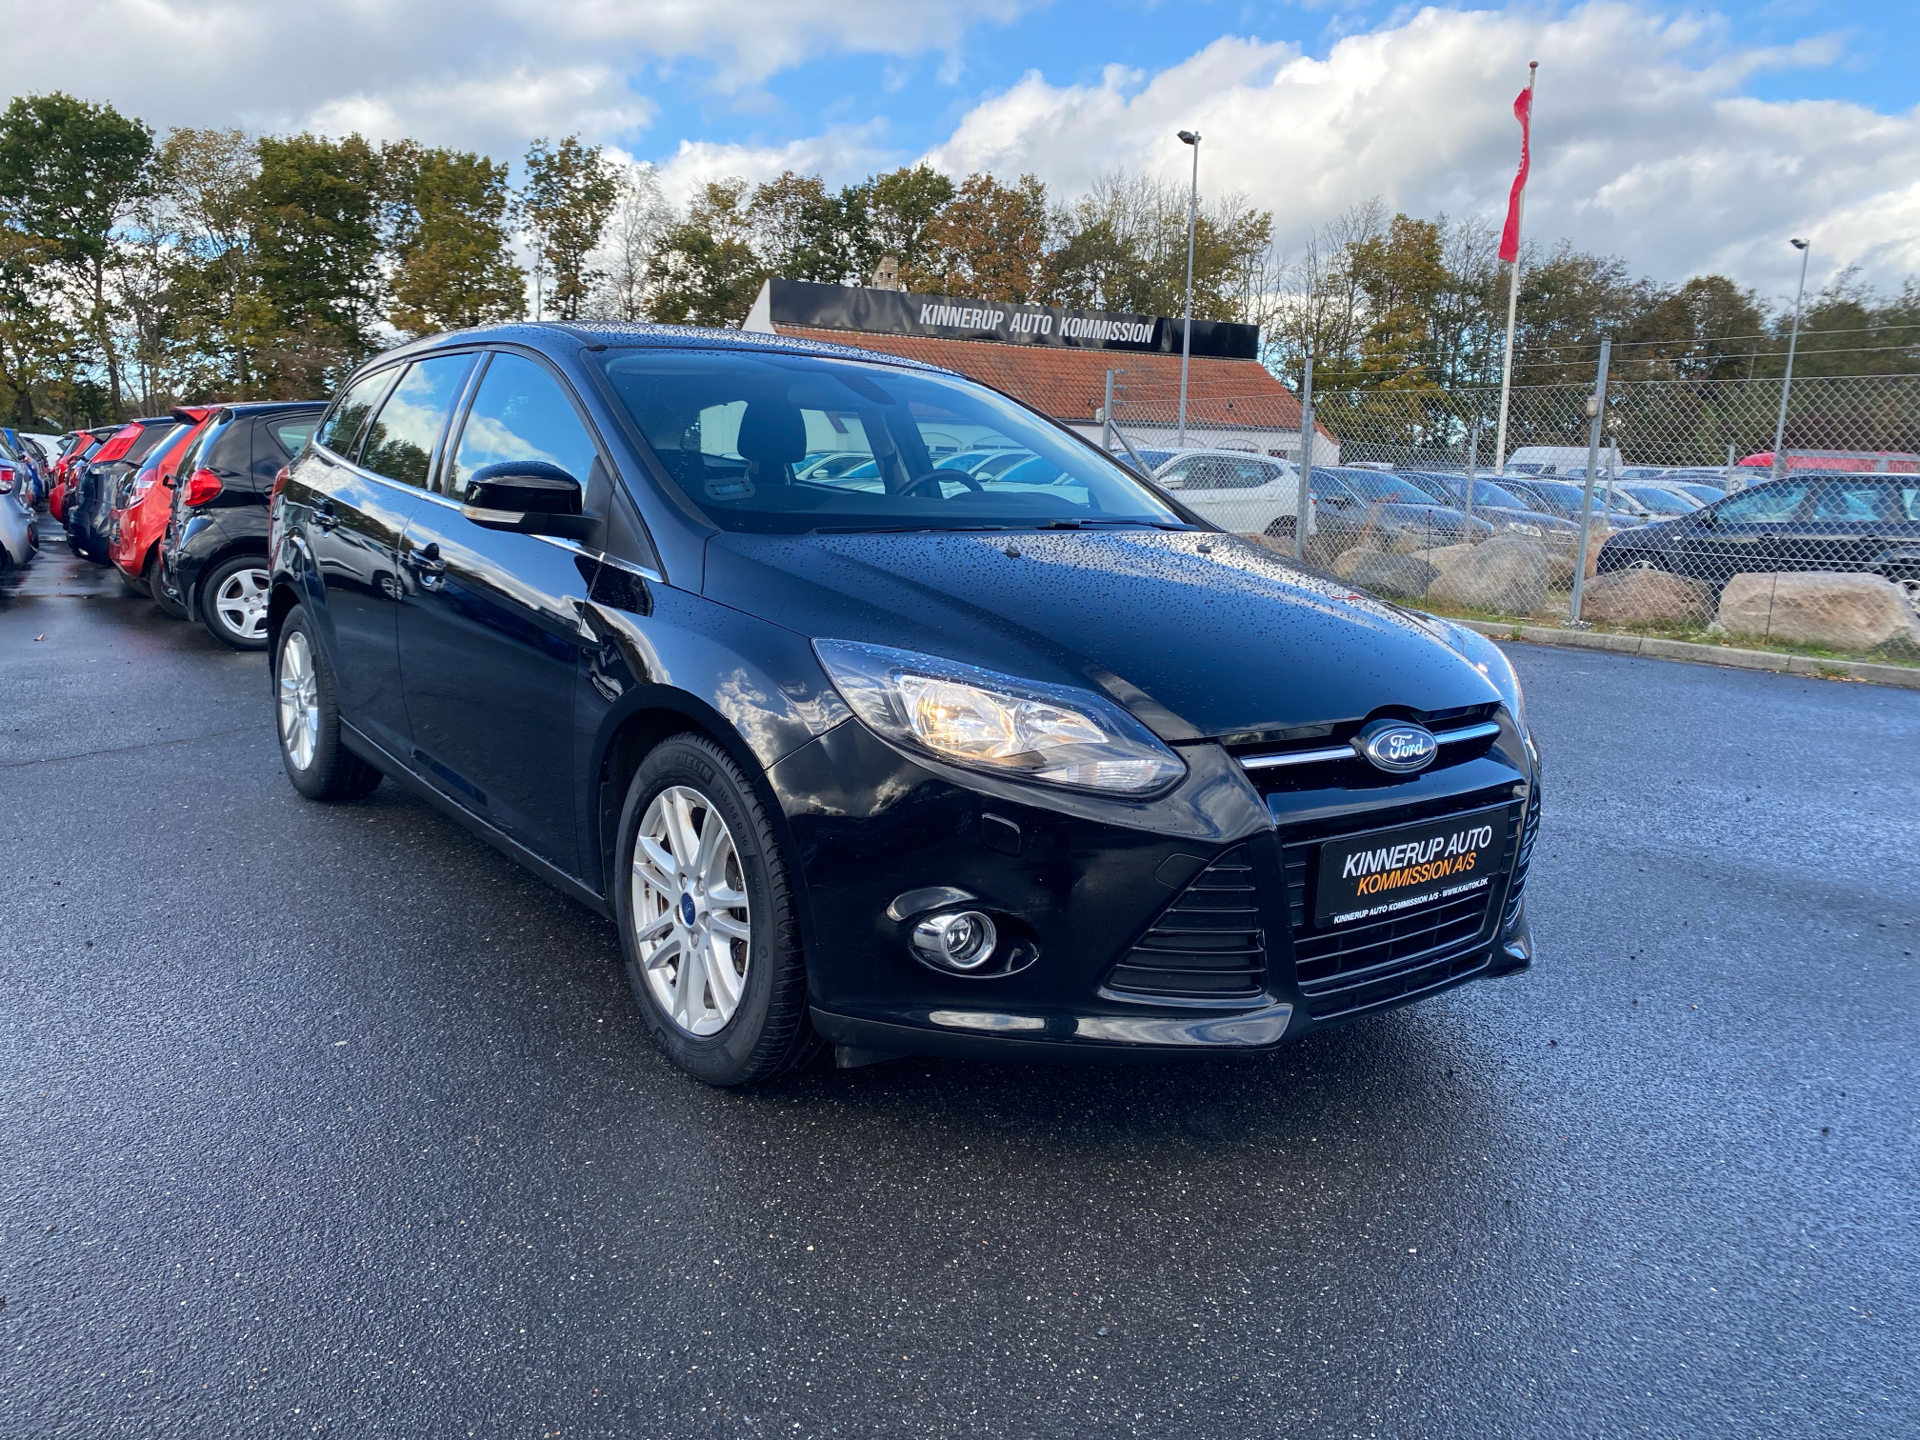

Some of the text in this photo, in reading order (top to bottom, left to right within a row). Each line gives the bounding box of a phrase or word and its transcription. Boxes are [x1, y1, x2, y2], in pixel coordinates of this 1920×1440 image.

[919, 303, 1154, 343] KINNERUP AUTO KOMMISSION
[1389, 734, 1425, 759] Ford
[1342, 825, 1493, 879] KINNERUP AUTO
[1357, 852, 1477, 896] KOMMISSION A/S
[1333, 909, 1369, 924] KINNERUP
[1369, 905, 1388, 917] AUTO
[1388, 894, 1428, 911] KOMMISSION
[1427, 891, 1439, 901] A/S
